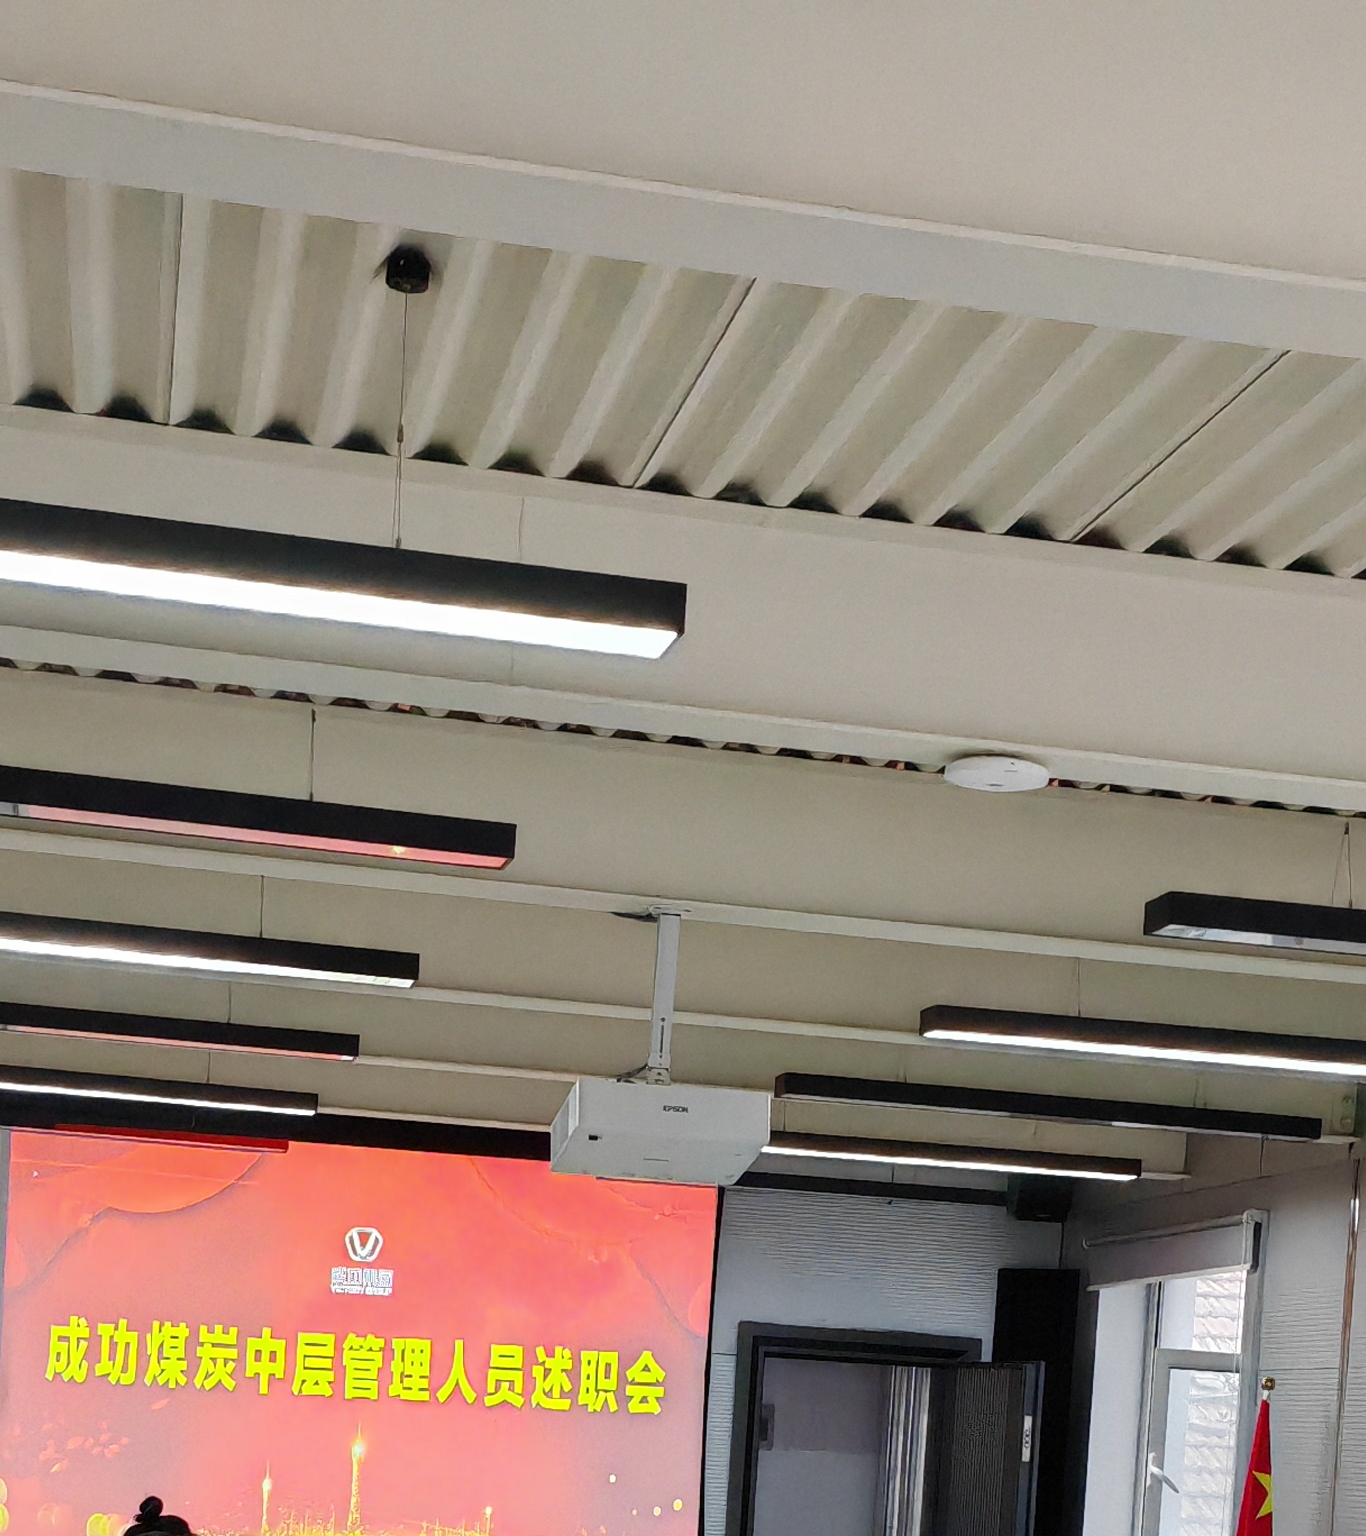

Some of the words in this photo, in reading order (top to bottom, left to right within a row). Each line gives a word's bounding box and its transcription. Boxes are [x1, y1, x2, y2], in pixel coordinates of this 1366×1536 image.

[45, 1315, 667, 1416] 成功煤炭中层管理人员述职会
